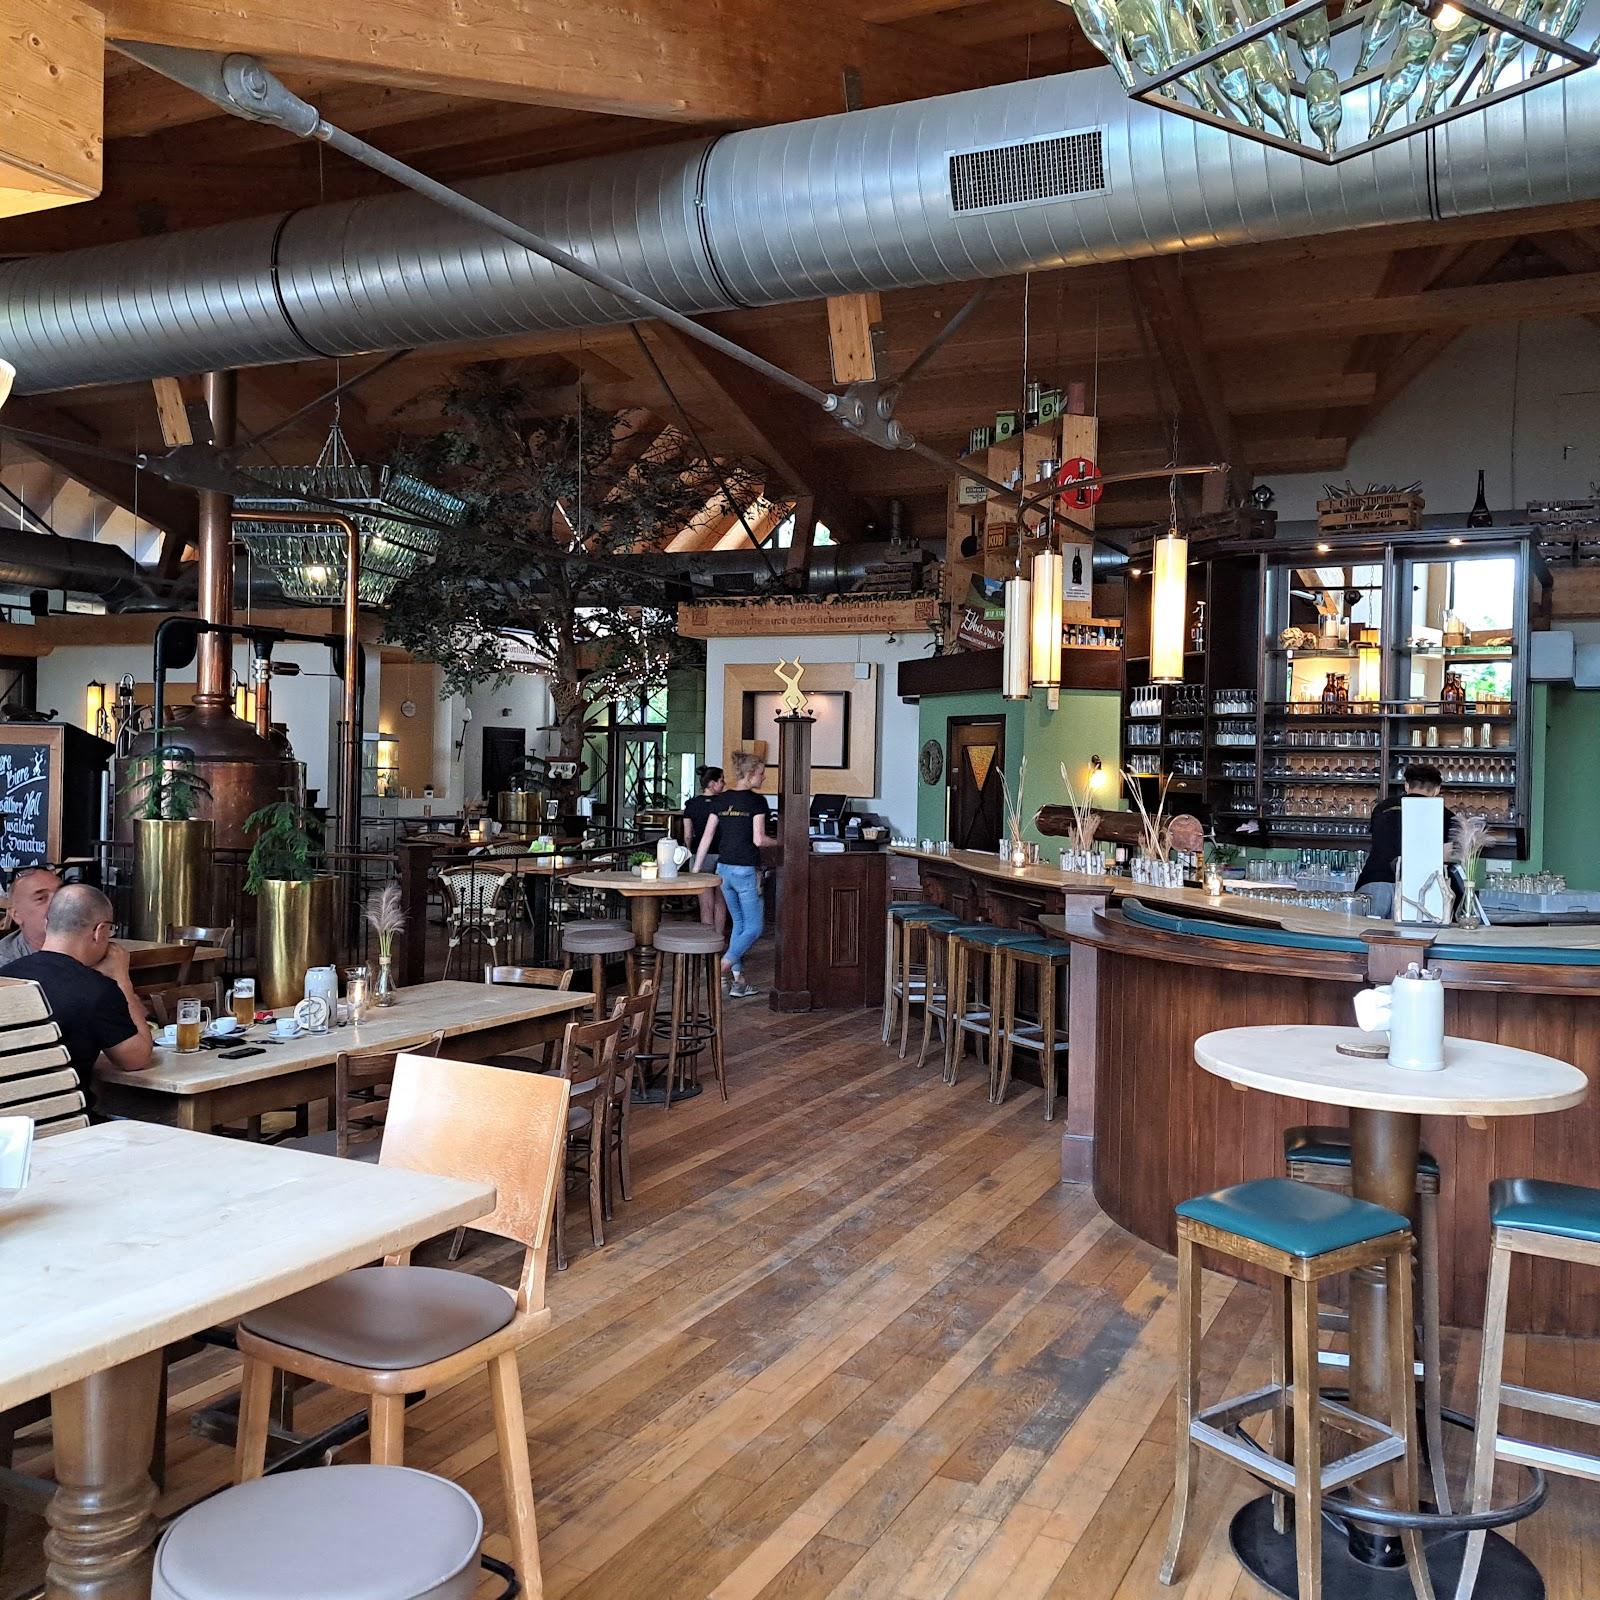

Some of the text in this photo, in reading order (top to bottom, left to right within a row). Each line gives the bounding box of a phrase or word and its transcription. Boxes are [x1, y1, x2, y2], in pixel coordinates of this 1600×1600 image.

[766, 617, 788, 625] auch
[7, 767, 30, 788] Biere
[6, 834, 46, 853] Donatus
